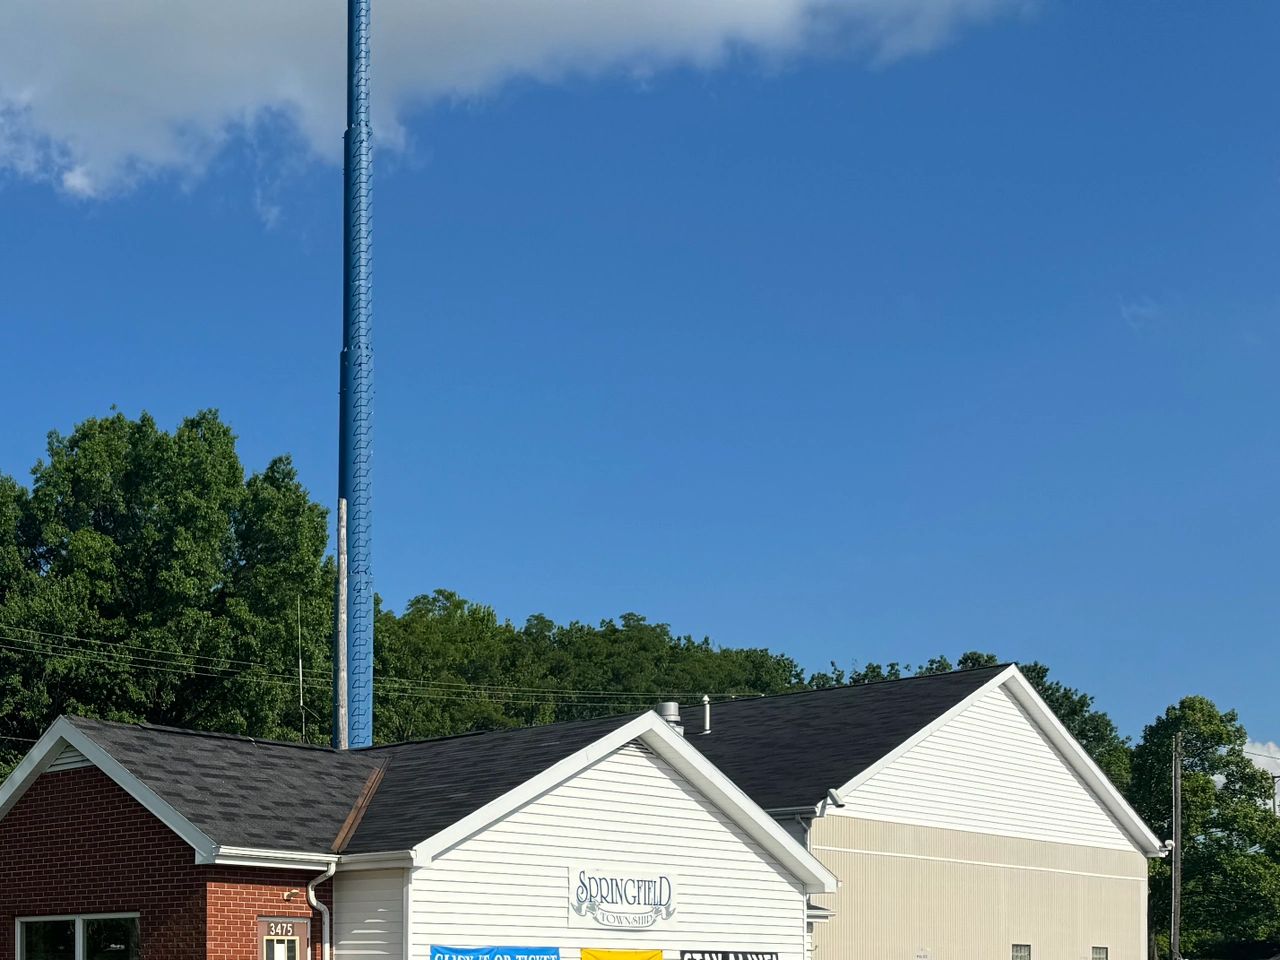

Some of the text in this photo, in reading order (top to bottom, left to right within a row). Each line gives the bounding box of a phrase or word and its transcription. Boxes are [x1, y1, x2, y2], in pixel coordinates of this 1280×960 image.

[576, 870, 672, 907] SPRINGFIELD
[599, 912, 653, 926] TOWNSHIP
[269, 923, 293, 936] 3475
